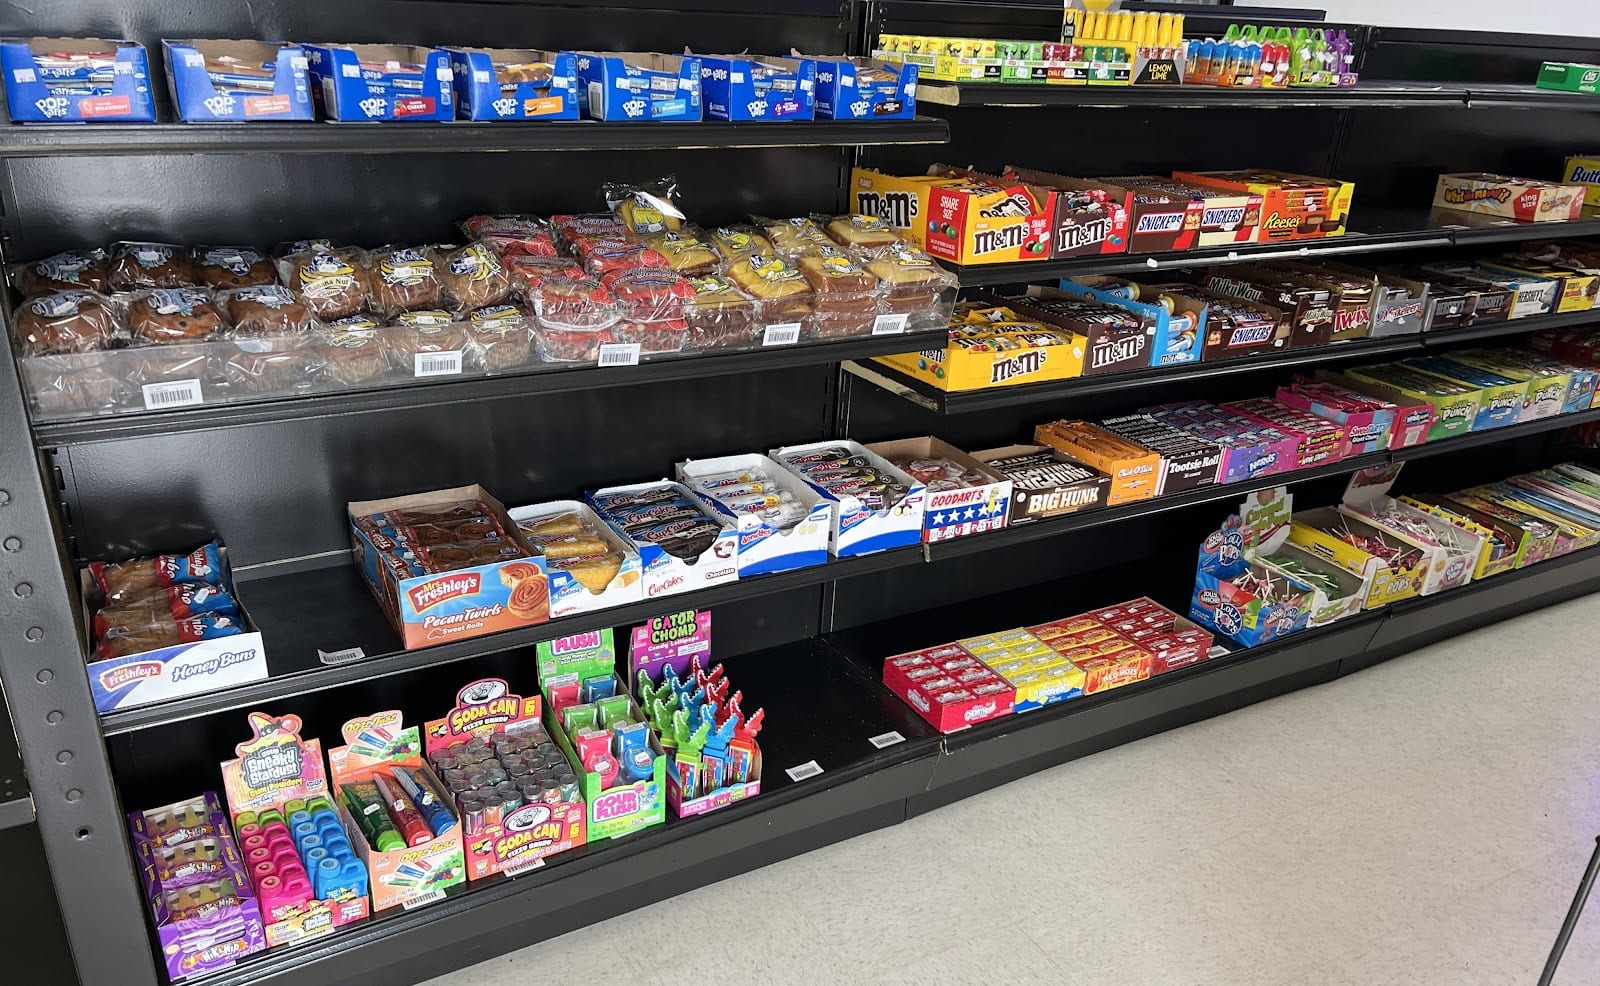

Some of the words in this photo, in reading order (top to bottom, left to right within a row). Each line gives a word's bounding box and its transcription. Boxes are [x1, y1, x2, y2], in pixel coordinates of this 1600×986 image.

[1149, 63, 1173, 74] LEMON
[1152, 71, 1167, 81] LIME
[940, 196, 960, 210] SHARE
[1520, 193, 1537, 203] king
[1521, 201, 1537, 209] size
[942, 208, 953, 220] SIZE
[1203, 208, 1244, 225] SNICKERS
[1262, 211, 1301, 230] Reese's
[1278, 292, 1291, 304] 36
[1517, 289, 1545, 303] HERSHEY'S
[1333, 306, 1371, 334] Twix
[1231, 325, 1272, 345] SNICKERS
[1441, 405, 1473, 421] PUNCH
[1490, 396, 1519, 411] PUNCH
[1169, 458, 1203, 474] Tootsie
[1201, 454, 1220, 467] Roll
[1027, 491, 1062, 514] BIG
[1059, 486, 1100, 508] HUNK
[645, 519, 697, 541] CupCakes
[1218, 544, 1241, 563] POPS
[704, 567, 736, 580] Chocolate
[414, 576, 478, 607] Freshley's
[648, 575, 685, 597] CupCakes
[423, 613, 465, 629] Pecan
[463, 603, 503, 623] Twirls
[652, 609, 696, 631] GATOR
[1213, 607, 1239, 635] POPS
[442, 625, 466, 636] Sweet
[465, 621, 484, 632] Rolls
[651, 624, 698, 644] CHOMP
[554, 632, 599, 653] FLUSH
[109, 664, 160, 687] Freshley's
[171, 658, 221, 683] Honey
[218, 649, 256, 669] Buns
[452, 705, 488, 733] SODA
[488, 699, 517, 717] CAN
[524, 699, 536, 714] 6
[247, 750, 295, 772] Sneaky
[250, 763, 298, 785] Stardust
[595, 802, 638, 821] FLUSH
[496, 831, 532, 860] SODA
[532, 823, 561, 839] CAN
